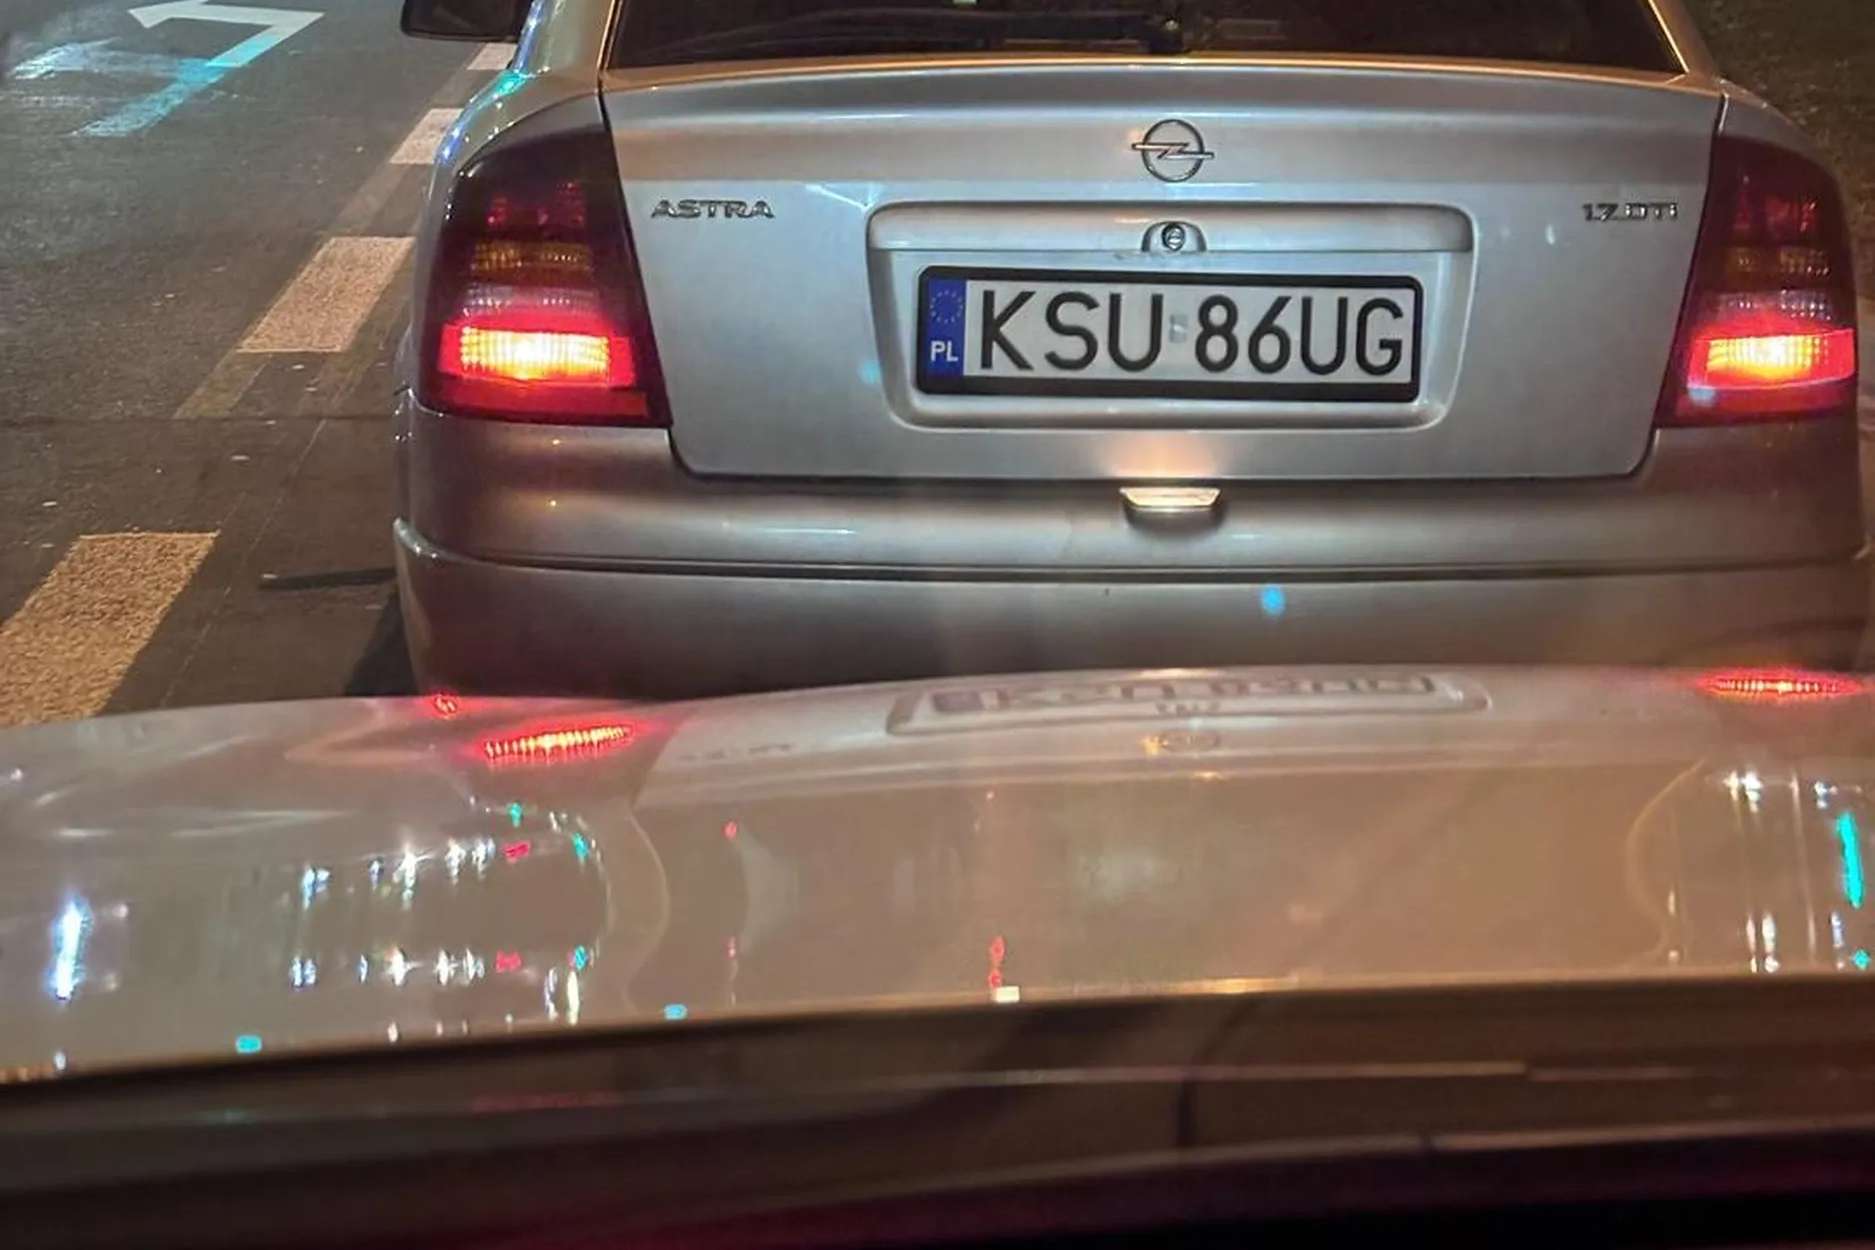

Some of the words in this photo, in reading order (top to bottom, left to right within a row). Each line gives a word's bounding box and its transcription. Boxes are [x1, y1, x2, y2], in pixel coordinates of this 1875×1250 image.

[651, 199, 775, 219] ASTRA
[981, 290, 1164, 373] KSU
[1195, 293, 1404, 376] 86UG
[930, 341, 959, 362] PL
